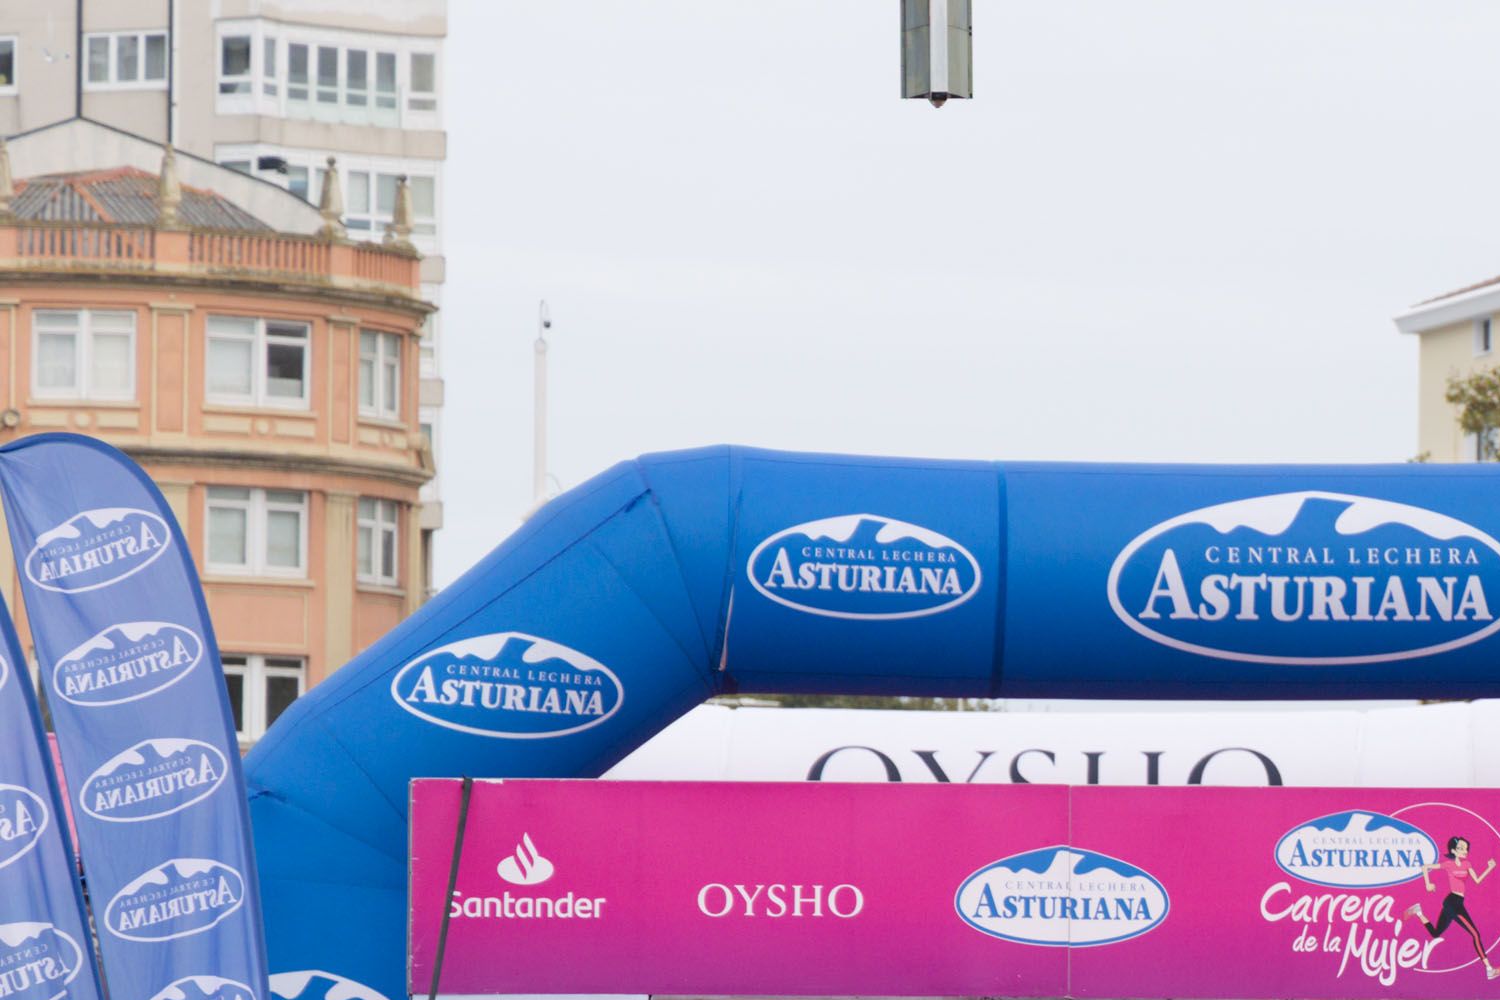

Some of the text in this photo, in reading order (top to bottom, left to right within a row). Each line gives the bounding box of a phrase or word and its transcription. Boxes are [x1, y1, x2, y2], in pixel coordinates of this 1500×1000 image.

[802, 546, 956, 562] CENTRAL LECHERA
[1204, 545, 1480, 564] CENTRAL LECHERA
[764, 547, 963, 595] ASTURIANA
[1139, 548, 1493, 622] ASTURIANA
[406, 665, 604, 715] ASTURIANA
[447, 664, 602, 685] CENTRAL LECHERA
[1288, 838, 1426, 868] ASTURIANA
[1313, 837, 1421, 846] CENTRAL LECHERA
[697, 883, 864, 917] OYSHO
[972, 882, 1153, 920] ASTURIANA
[1005, 880, 1146, 892] CENTRAL LECHERA
[1260, 881, 1396, 923] Carrera
[449, 891, 606, 919] Santander
[1292, 919, 1445, 987] de la Mujer
